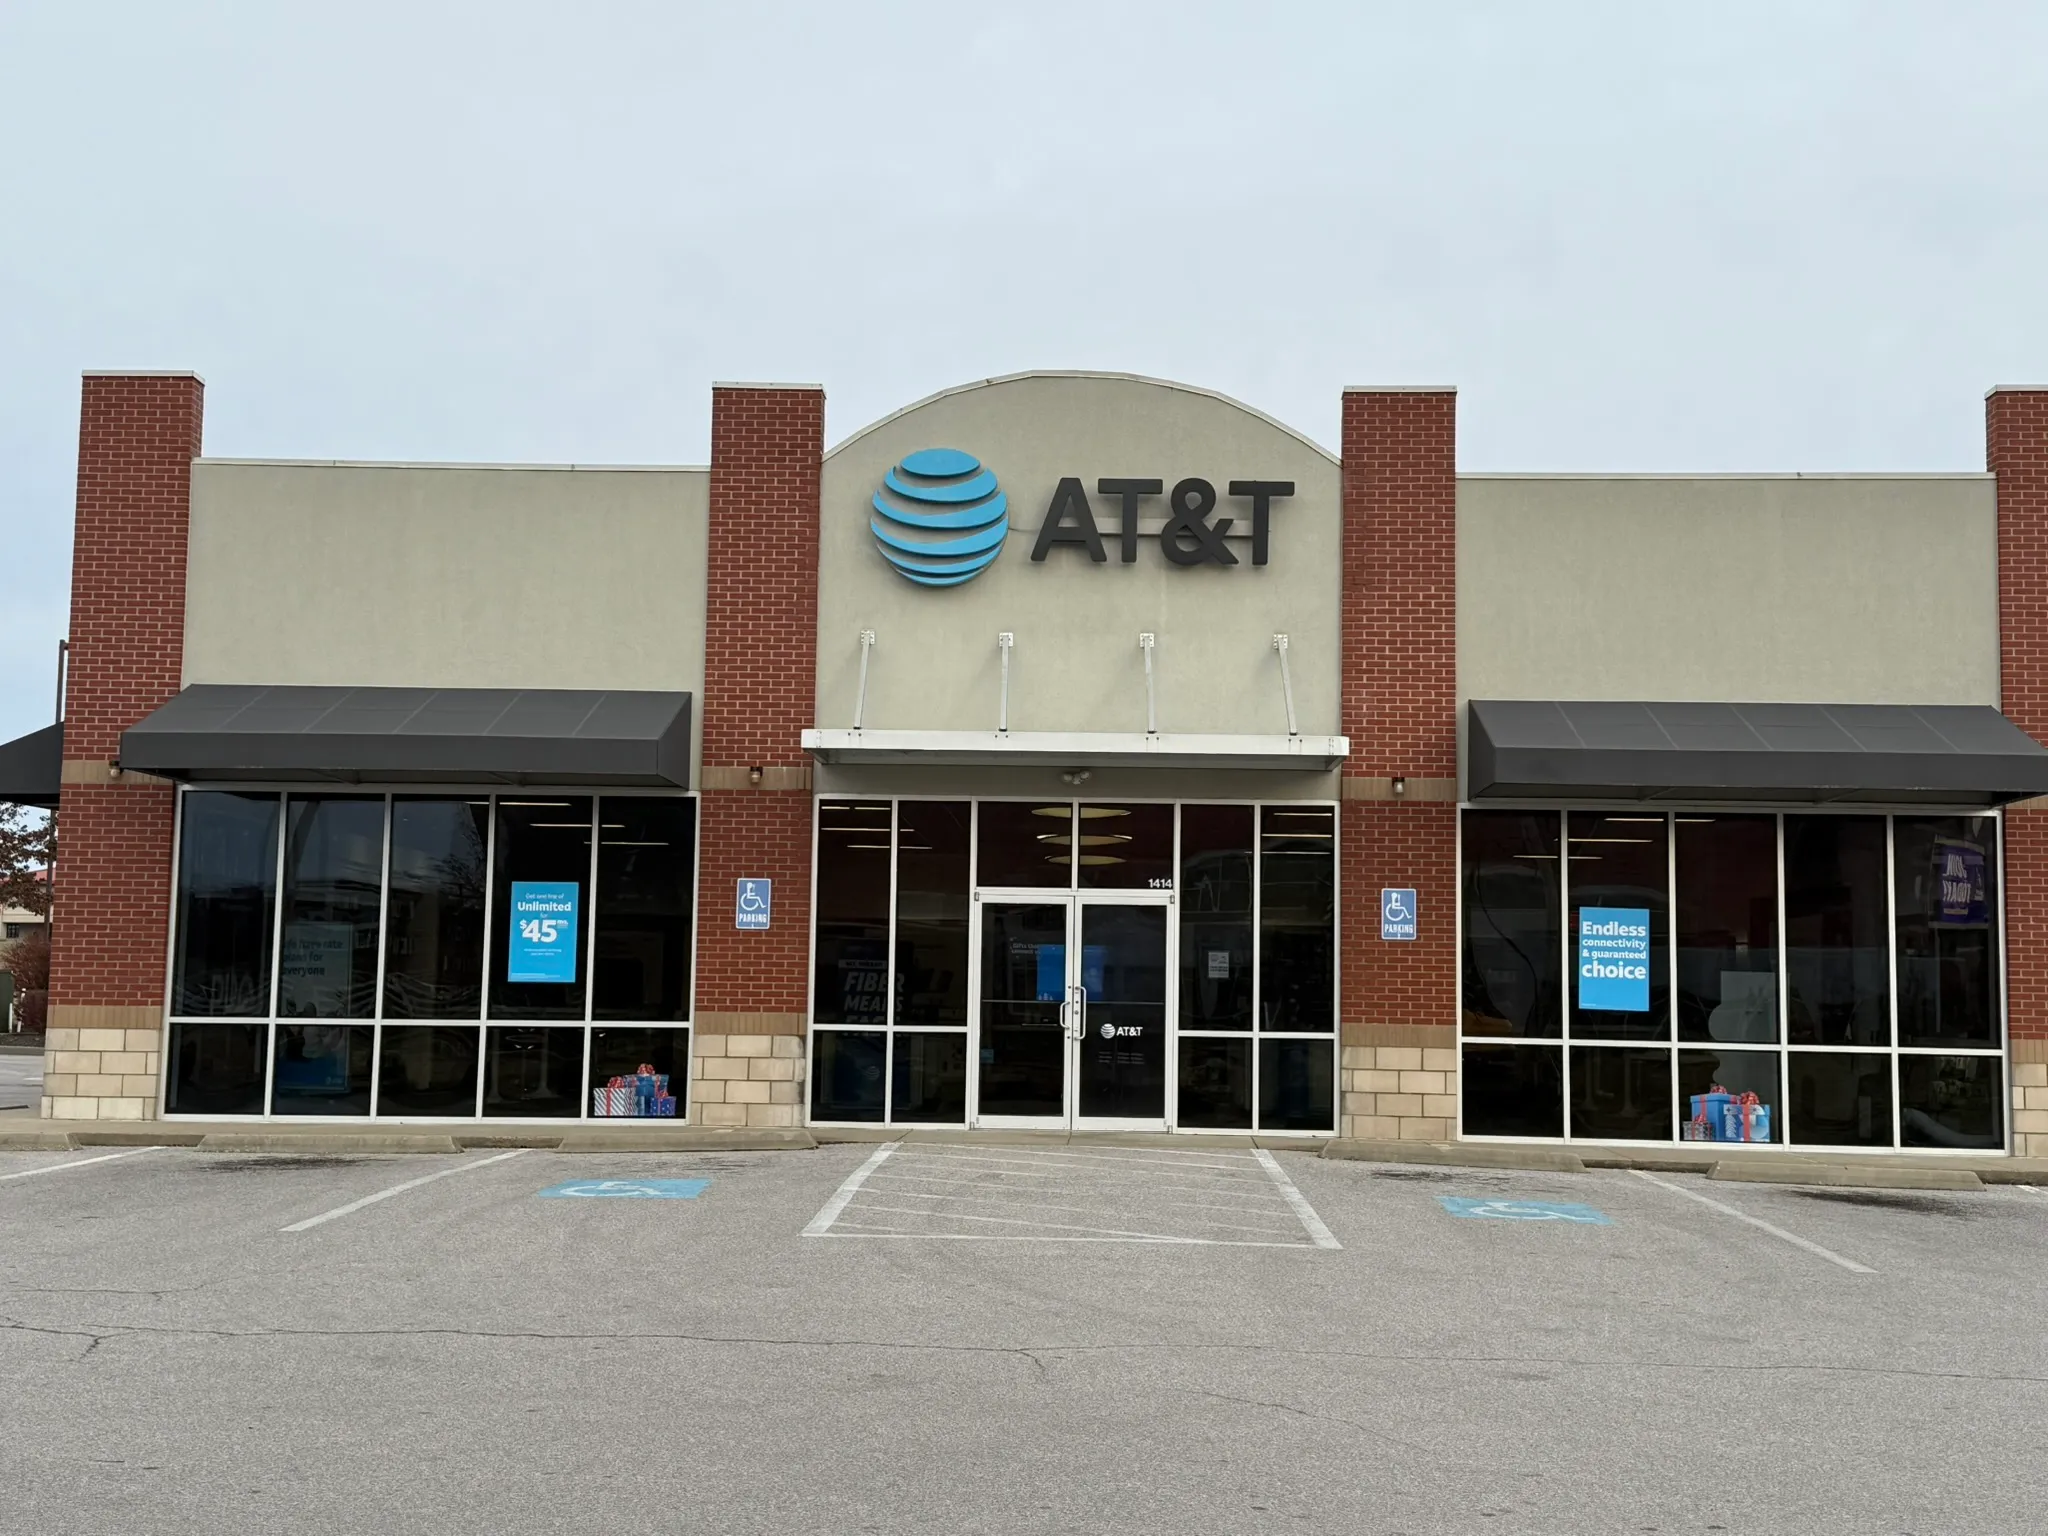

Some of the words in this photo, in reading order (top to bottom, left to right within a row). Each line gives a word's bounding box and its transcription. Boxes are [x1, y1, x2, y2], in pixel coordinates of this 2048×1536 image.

[1030, 477, 1295, 566] AT&T
[1147, 878, 1172, 888] 1414
[517, 902, 572, 911] Unlimited
[738, 913, 767, 923] PARKING
[519, 919, 557, 943] $45
[1384, 923, 1414, 934] PARKING
[1582, 921, 1647, 937] Endless
[1582, 938, 1646, 950] connectivity
[309, 951, 323, 961] for
[1582, 949, 1589, 957] &
[1591, 950, 1647, 960] guaranteed
[1581, 960, 1647, 979] choice
[843, 971, 905, 993] FIBER
[1116, 1026, 1143, 1037] AT&T
